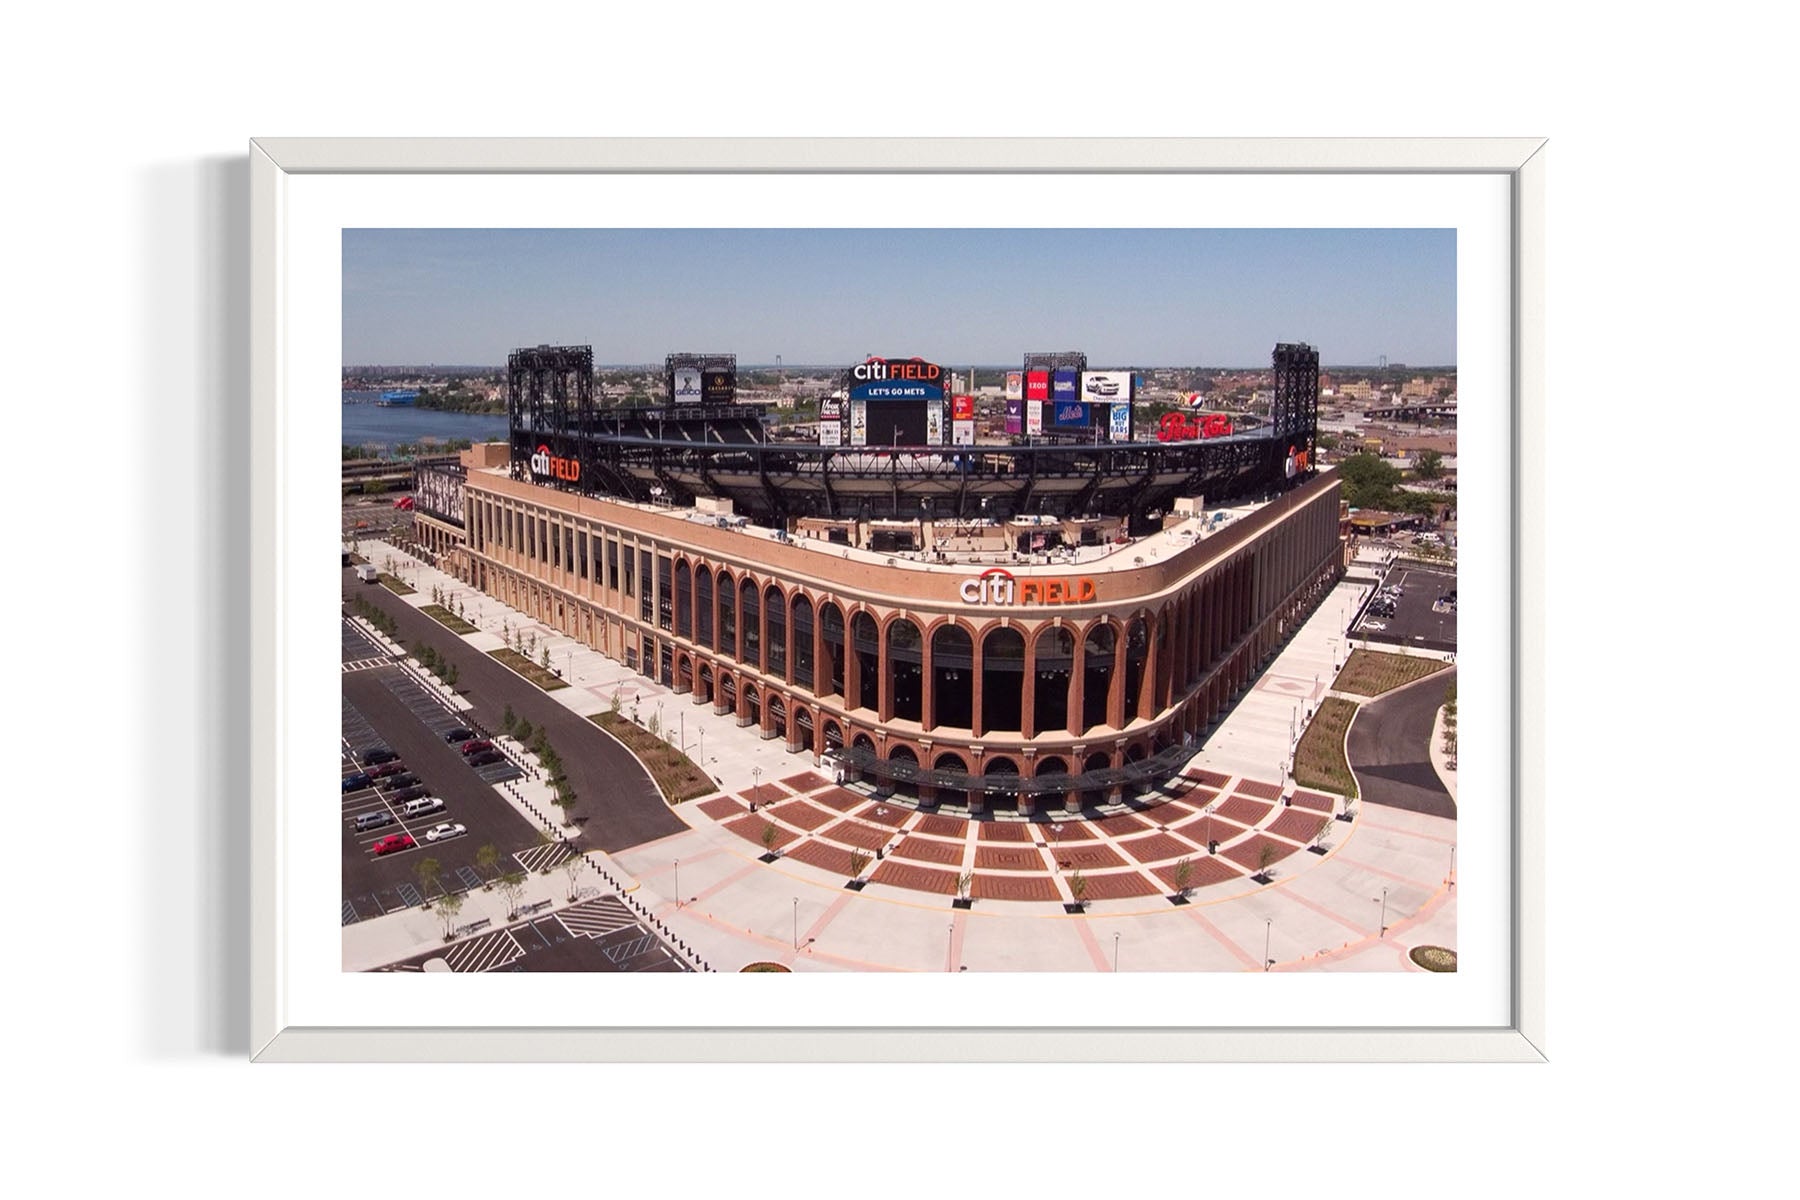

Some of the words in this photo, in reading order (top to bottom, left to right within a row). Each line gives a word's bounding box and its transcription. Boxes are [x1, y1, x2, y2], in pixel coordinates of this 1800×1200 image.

[890, 364, 940, 379] FIELD
[868, 388, 890, 396] LET'S
[891, 388, 903, 396] GO
[904, 388, 925, 396] METS
[1058, 405, 1083, 421] Mets
[1112, 411, 1127, 421] BIG
[550, 456, 580, 482] FIELD
[1020, 576, 1097, 603] FIELD
